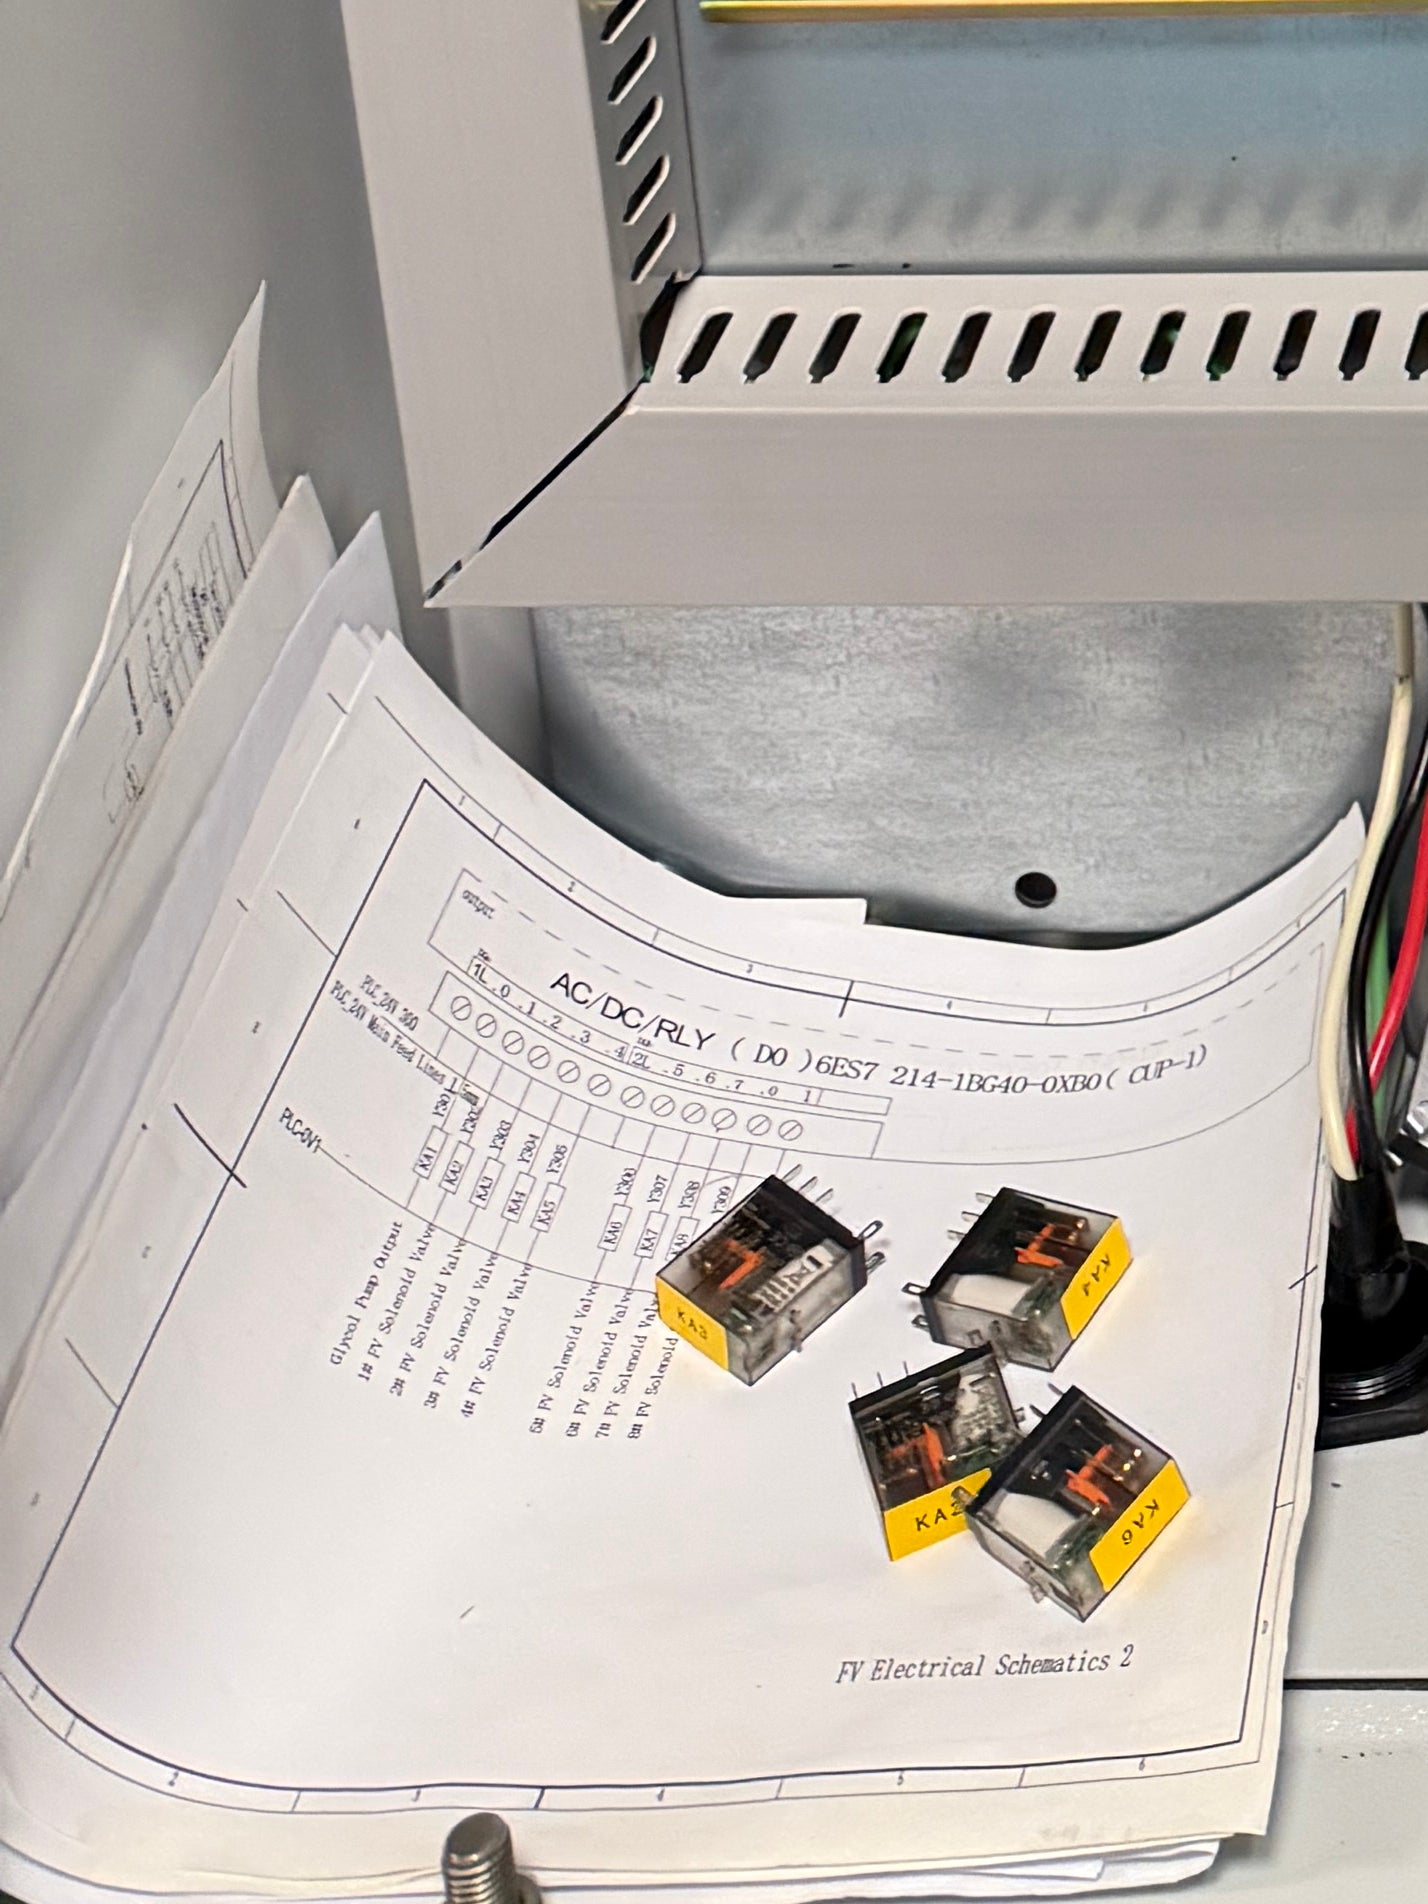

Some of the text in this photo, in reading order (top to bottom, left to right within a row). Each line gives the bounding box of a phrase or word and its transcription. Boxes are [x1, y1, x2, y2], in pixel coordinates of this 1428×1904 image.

[462, 887, 495, 920] output
[472, 961, 652, 1070] 1L 2L
[549, 971, 717, 1052] AC/DC/RLY
[389, 1035, 447, 1086] Feed Lines
[418, 1146, 438, 1172] KA1
[443, 1159, 464, 1186] KA2
[546, 1143, 569, 1176] Y305
[474, 1174, 494, 1202] KA3
[506, 1189, 527, 1217] KA4
[535, 1199, 556, 1227] KA5
[646, 1174, 668, 1205] Y307
[602, 1220, 624, 1249] KA6
[638, 1227, 661, 1254] KA7
[354, 1221, 404, 1311] Pump Output
[378, 1222, 436, 1336] Solenoid Valve
[410, 1238, 467, 1351] Solenoid Valve
[443, 1249, 499, 1363] Solenoid Valve
[478, 1260, 533, 1373] Solenoid Valve
[548, 1280, 598, 1389] Solenoid Valve
[582, 1287, 633, 1393] Solenoid Valve
[612, 1334, 648, 1396] Solenoid
[649, 1336, 680, 1396] Solenoid
[835, 1642, 1135, 1685] FV Electrical Schematics 2
